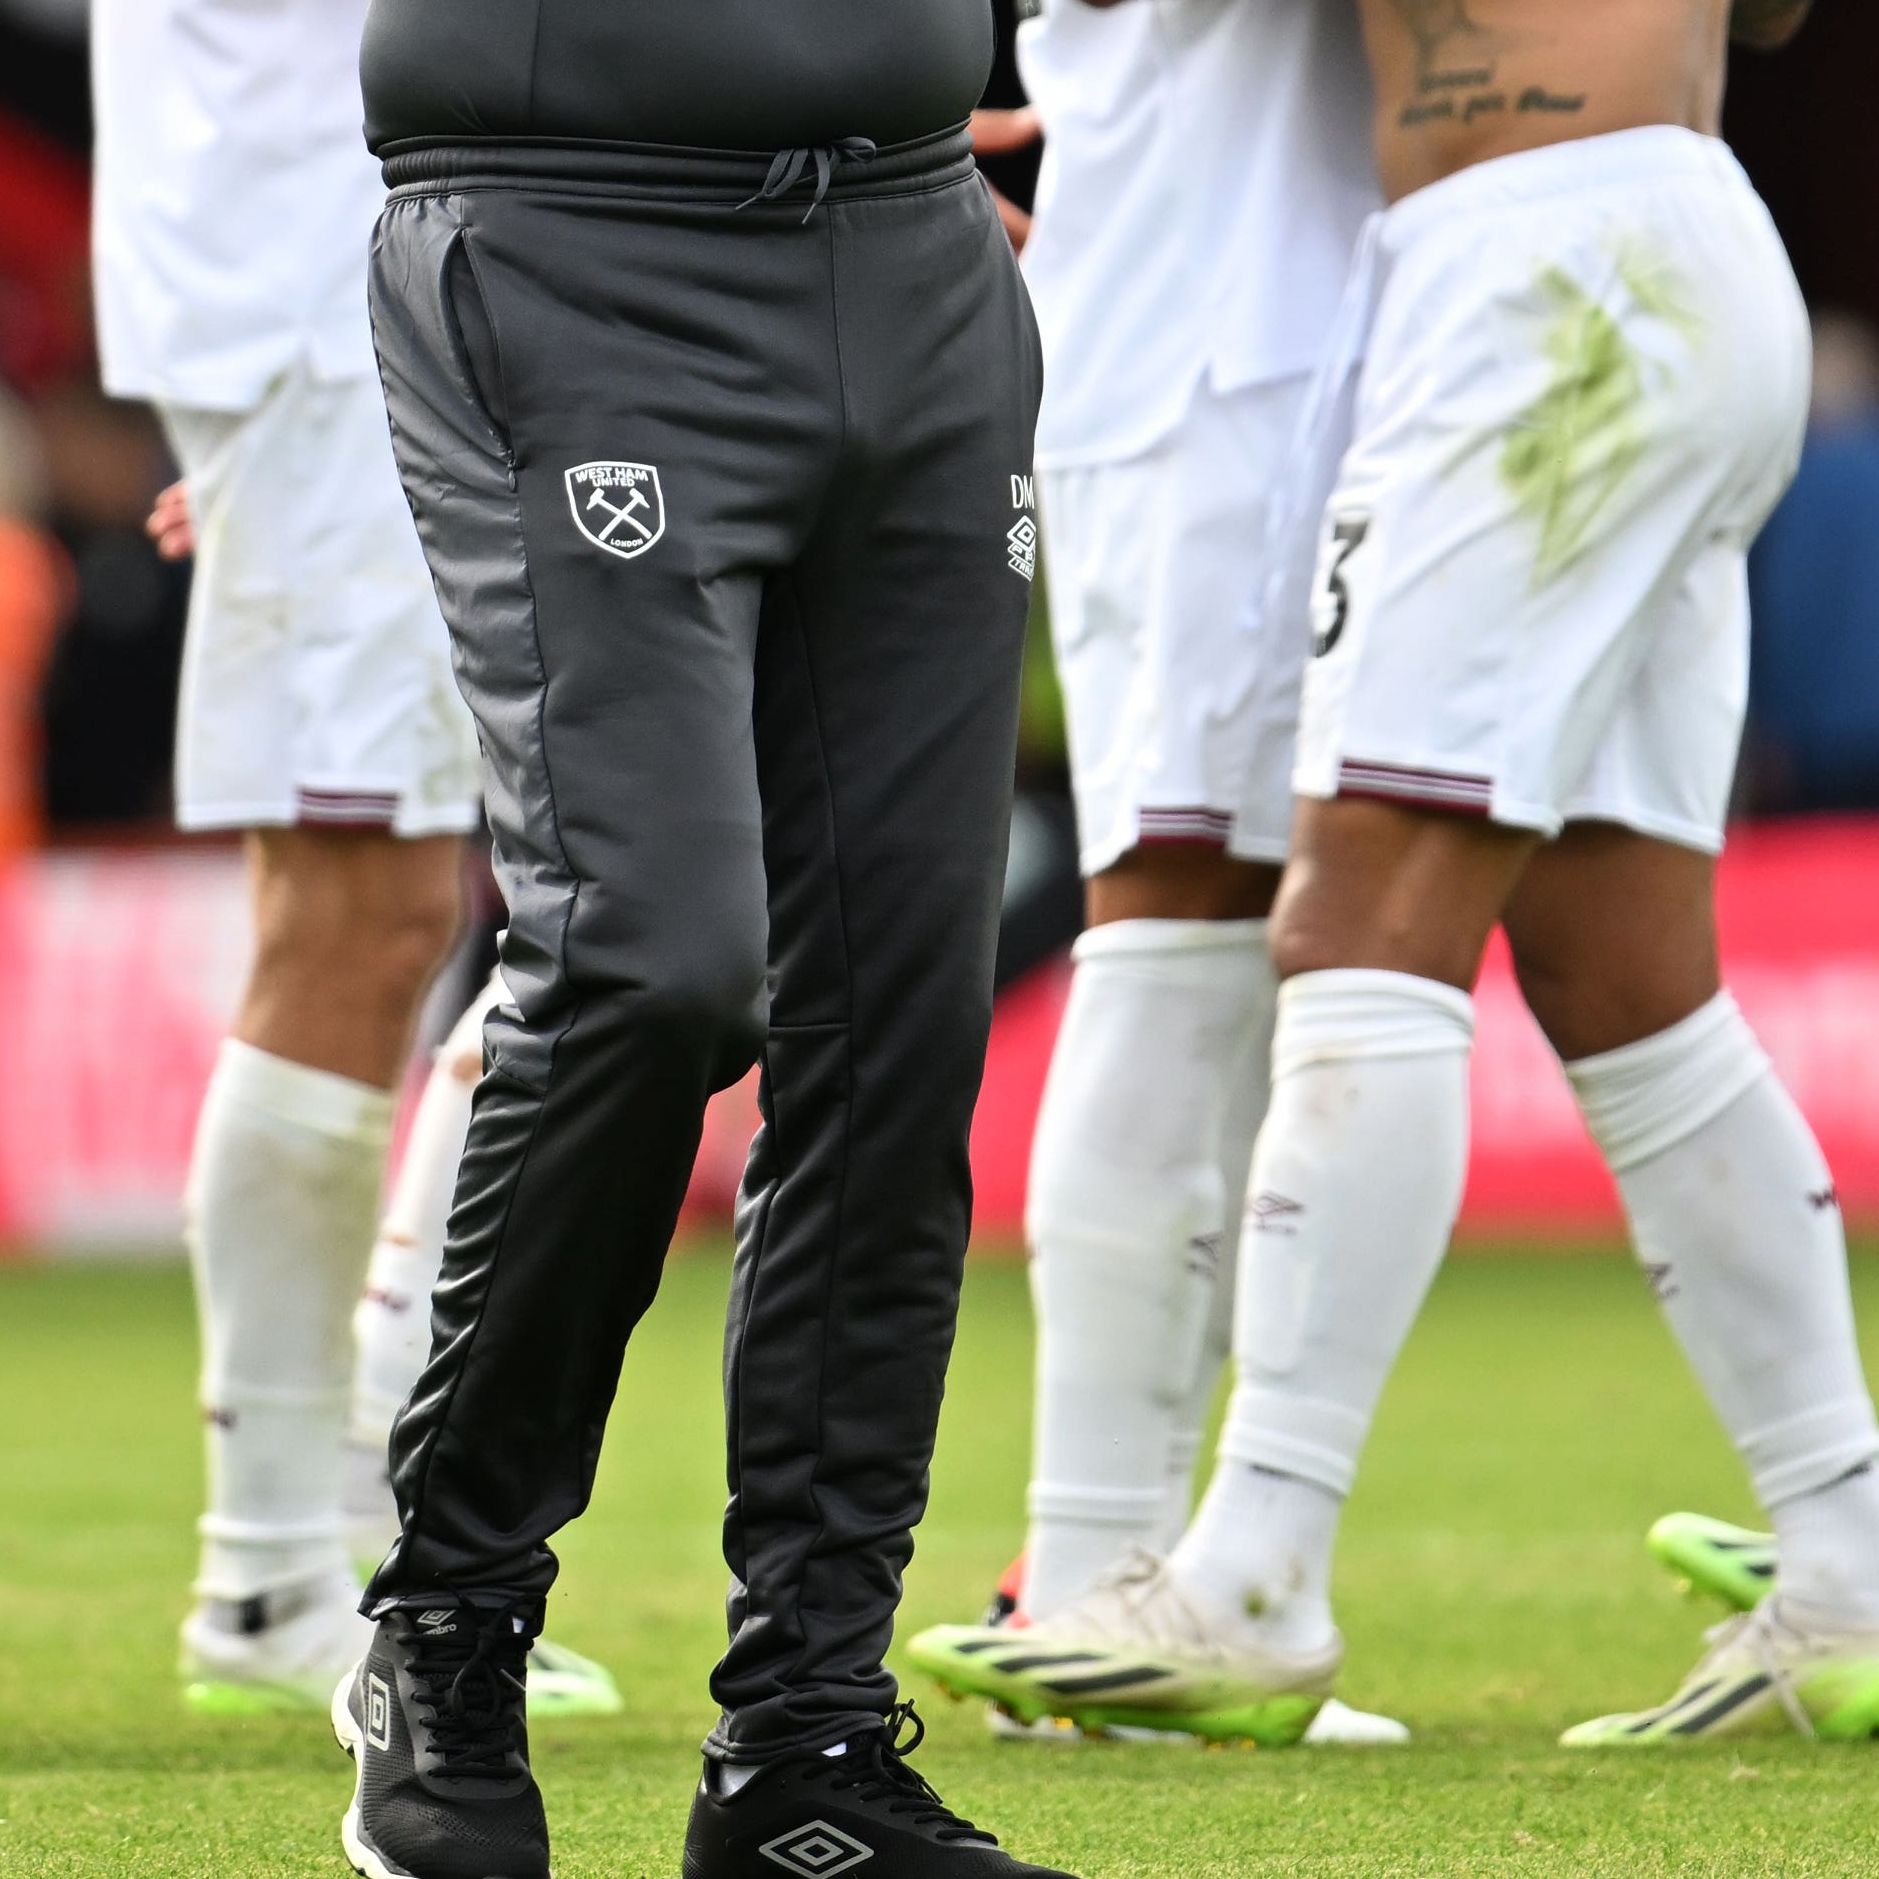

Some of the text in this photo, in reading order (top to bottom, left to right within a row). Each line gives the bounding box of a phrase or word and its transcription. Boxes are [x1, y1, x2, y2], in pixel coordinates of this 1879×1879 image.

[575, 466, 649, 483] WEST HAM
[591, 477, 636, 488] UNITED
[1010, 474, 1035, 510] DM
[610, 537, 644, 548] LONDON
